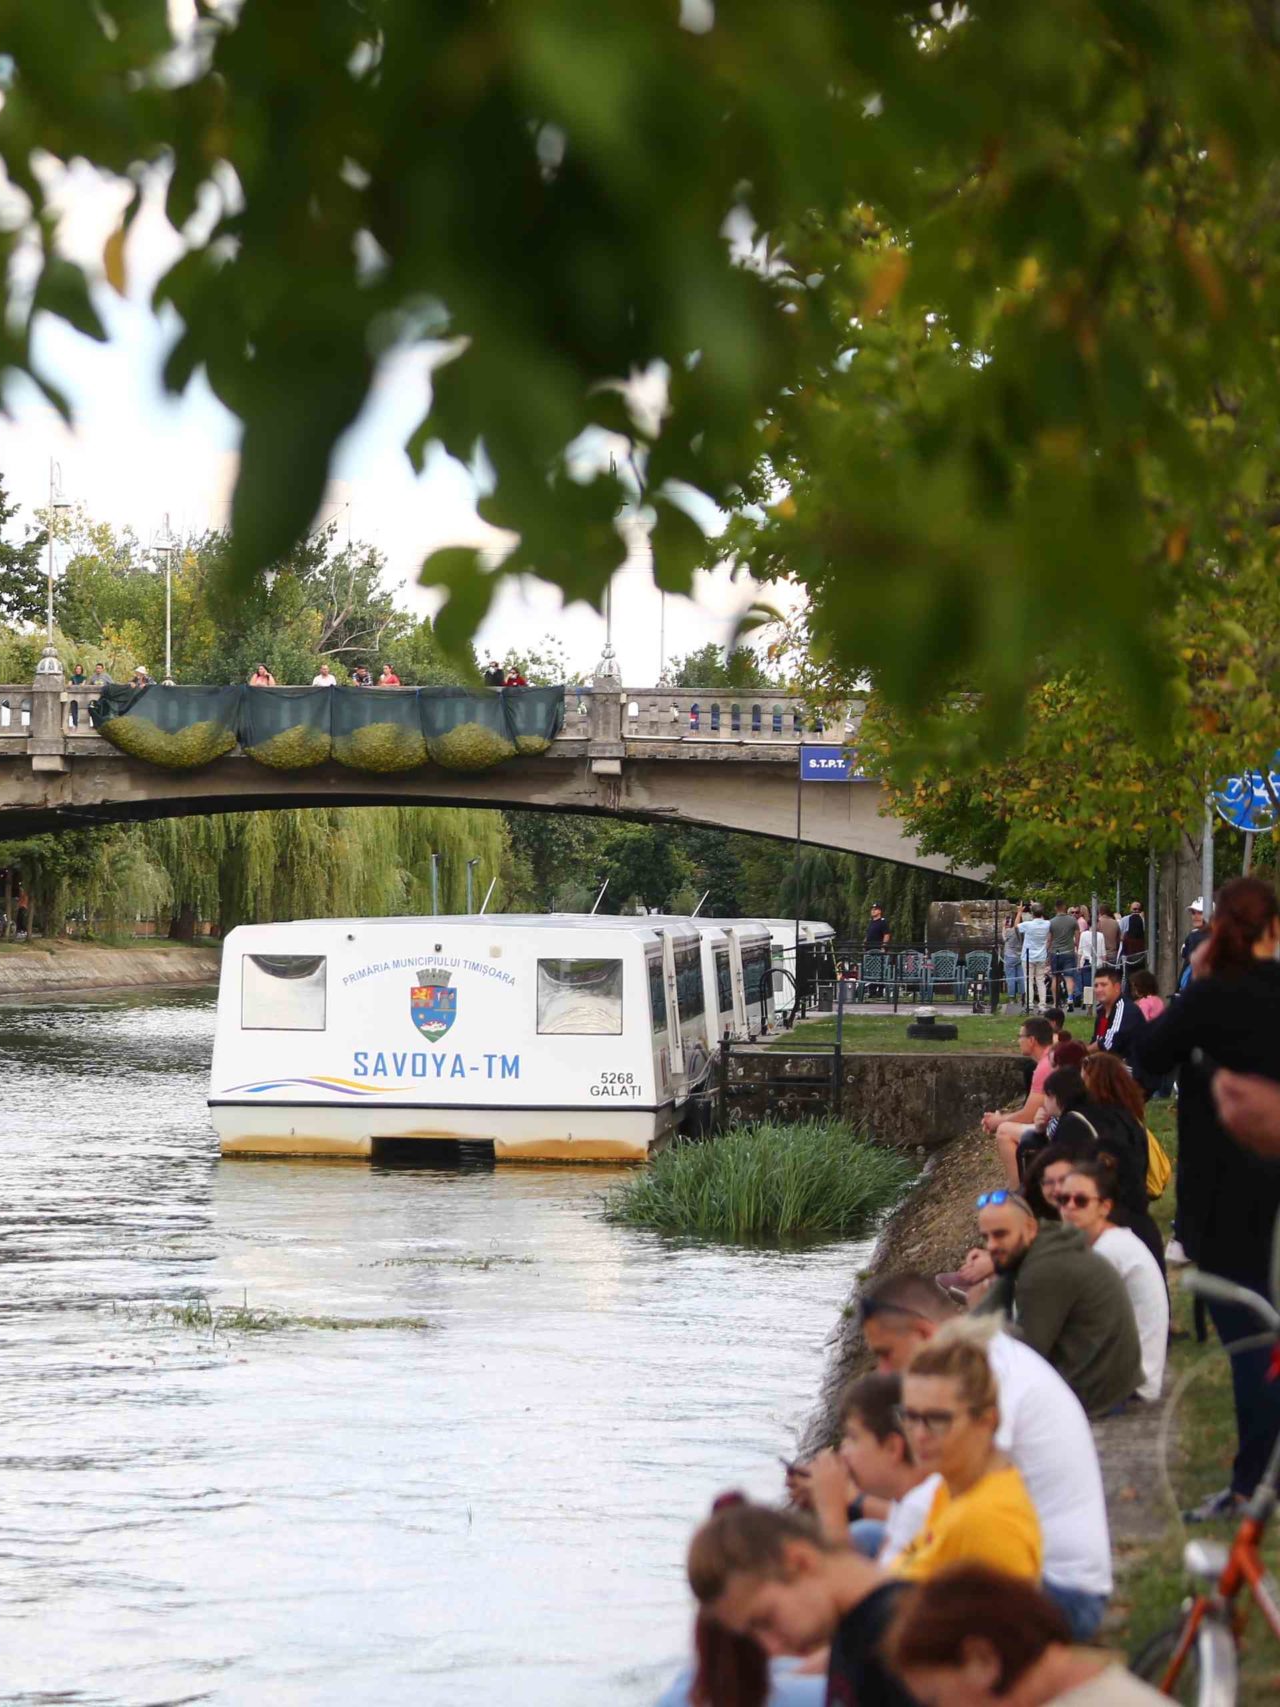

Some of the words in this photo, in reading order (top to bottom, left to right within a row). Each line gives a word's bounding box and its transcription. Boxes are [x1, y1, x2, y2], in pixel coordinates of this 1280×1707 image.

[809, 759, 846, 769] S.T.P.T.
[392, 956, 461, 970] MUNICIPIULUI
[353, 1051, 521, 1079] SAVOYA-TM
[600, 1072, 634, 1085] 5268
